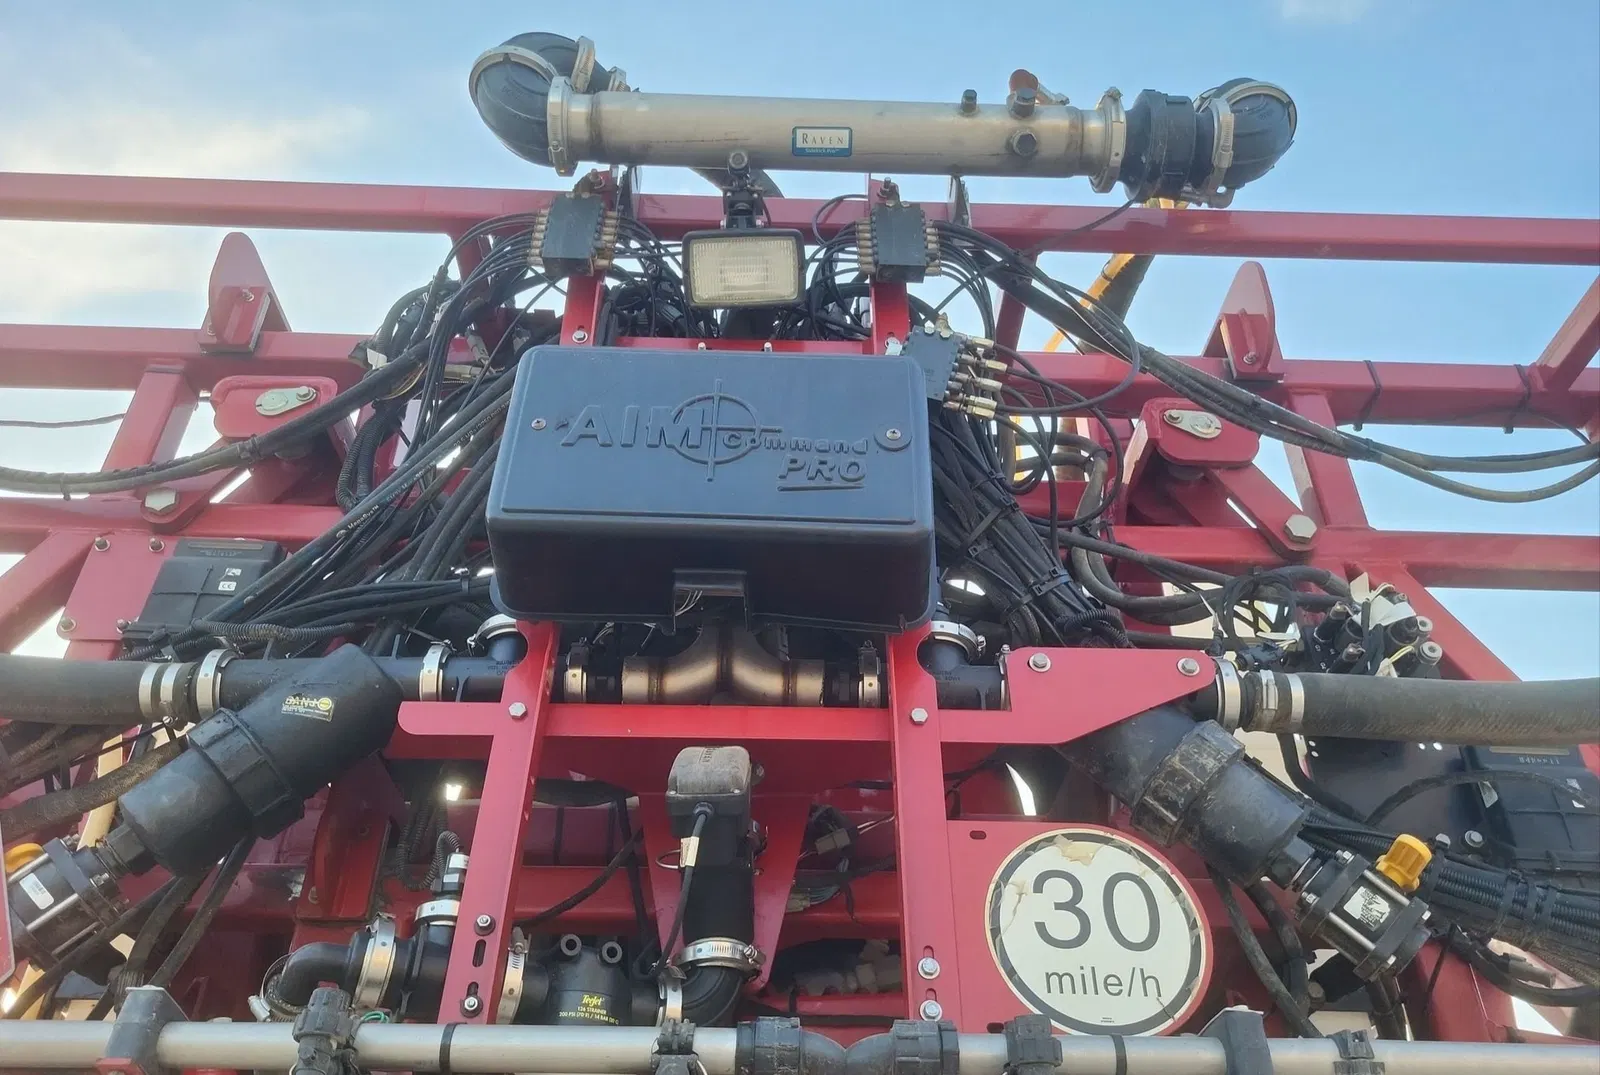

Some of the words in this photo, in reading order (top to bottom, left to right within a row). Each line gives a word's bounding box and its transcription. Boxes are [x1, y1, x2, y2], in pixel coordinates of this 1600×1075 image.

[560, 404, 703, 449] AIM
[777, 454, 868, 482] PRO
[1032, 869, 1161, 952] 30
[1045, 965, 1162, 998] mile/h
